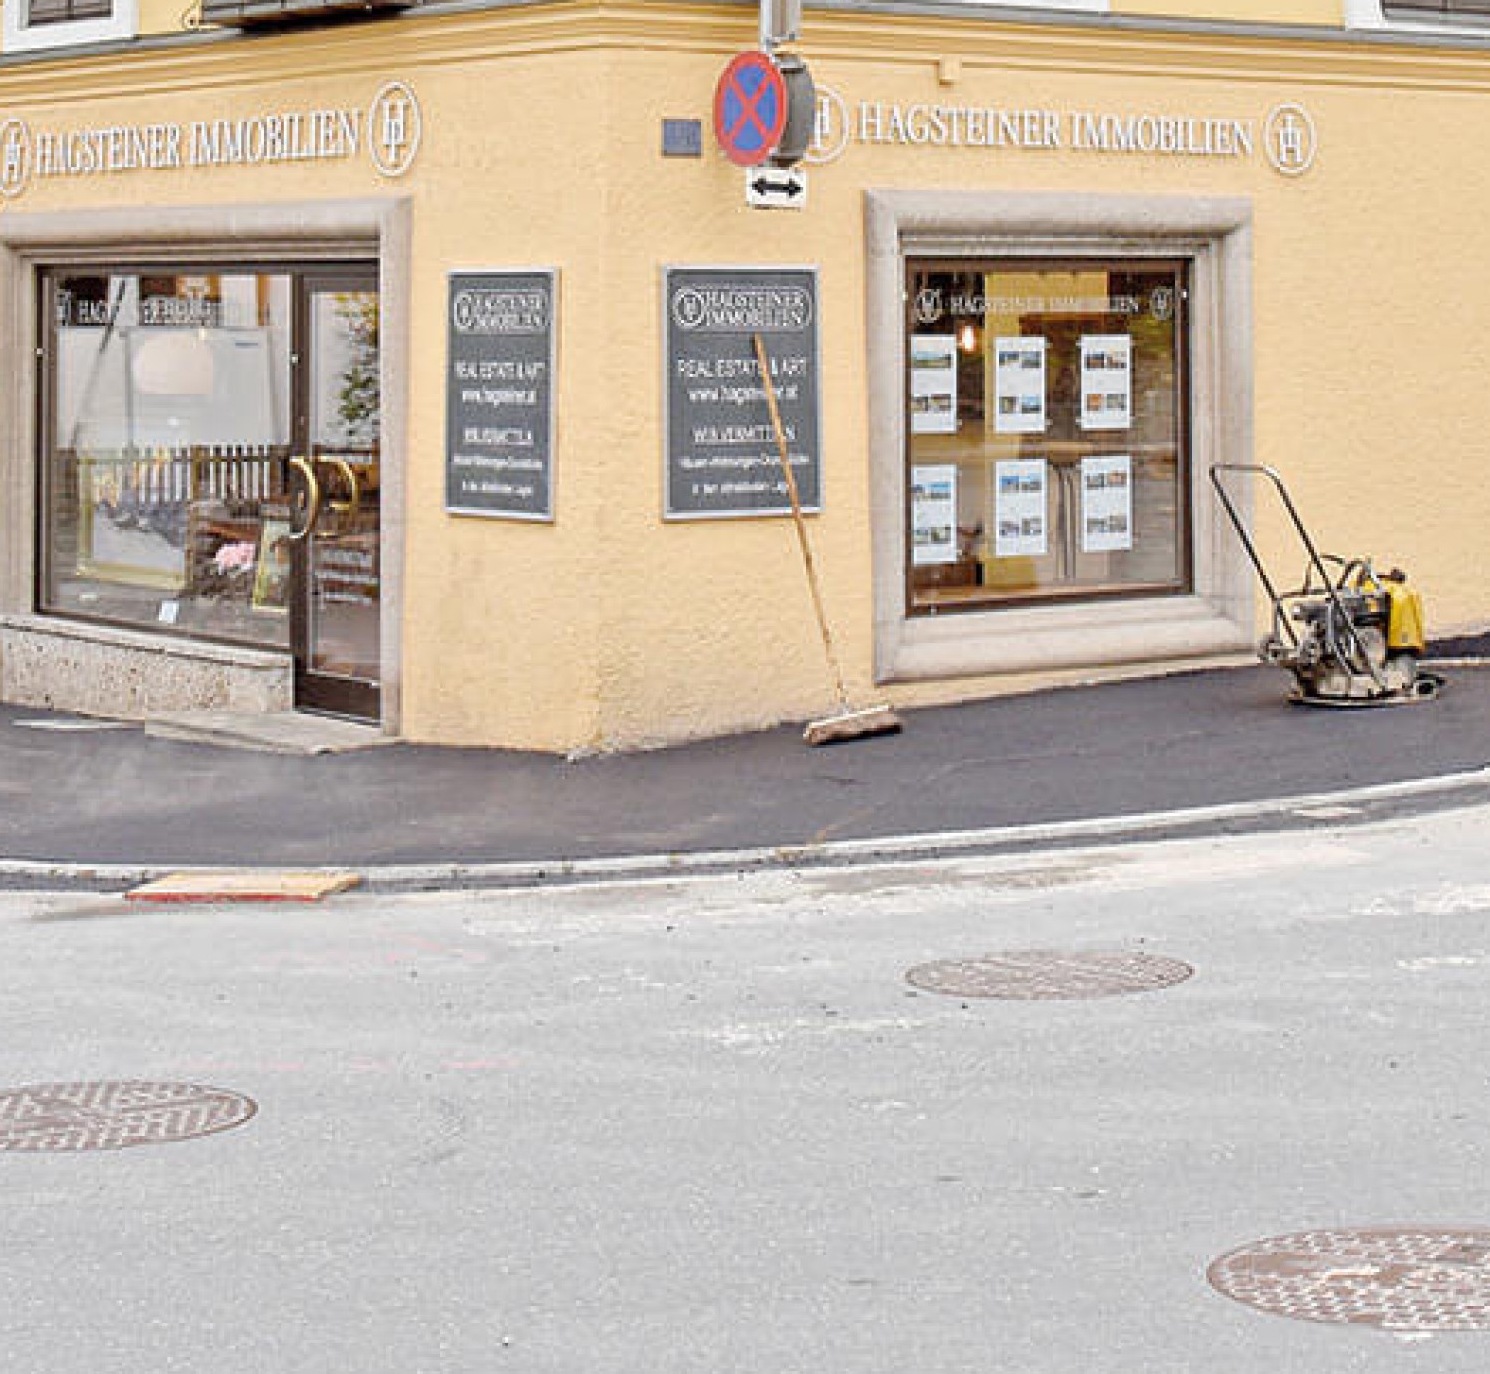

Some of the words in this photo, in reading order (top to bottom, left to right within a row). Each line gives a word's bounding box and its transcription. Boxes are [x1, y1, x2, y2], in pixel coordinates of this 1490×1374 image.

[35, 122, 183, 176] HAGSTEINER
[189, 108, 363, 167] IMMOBILIEN
[858, 100, 1061, 151] HAGSTEINER
[1072, 113, 1254, 158] IMMOBILIEN
